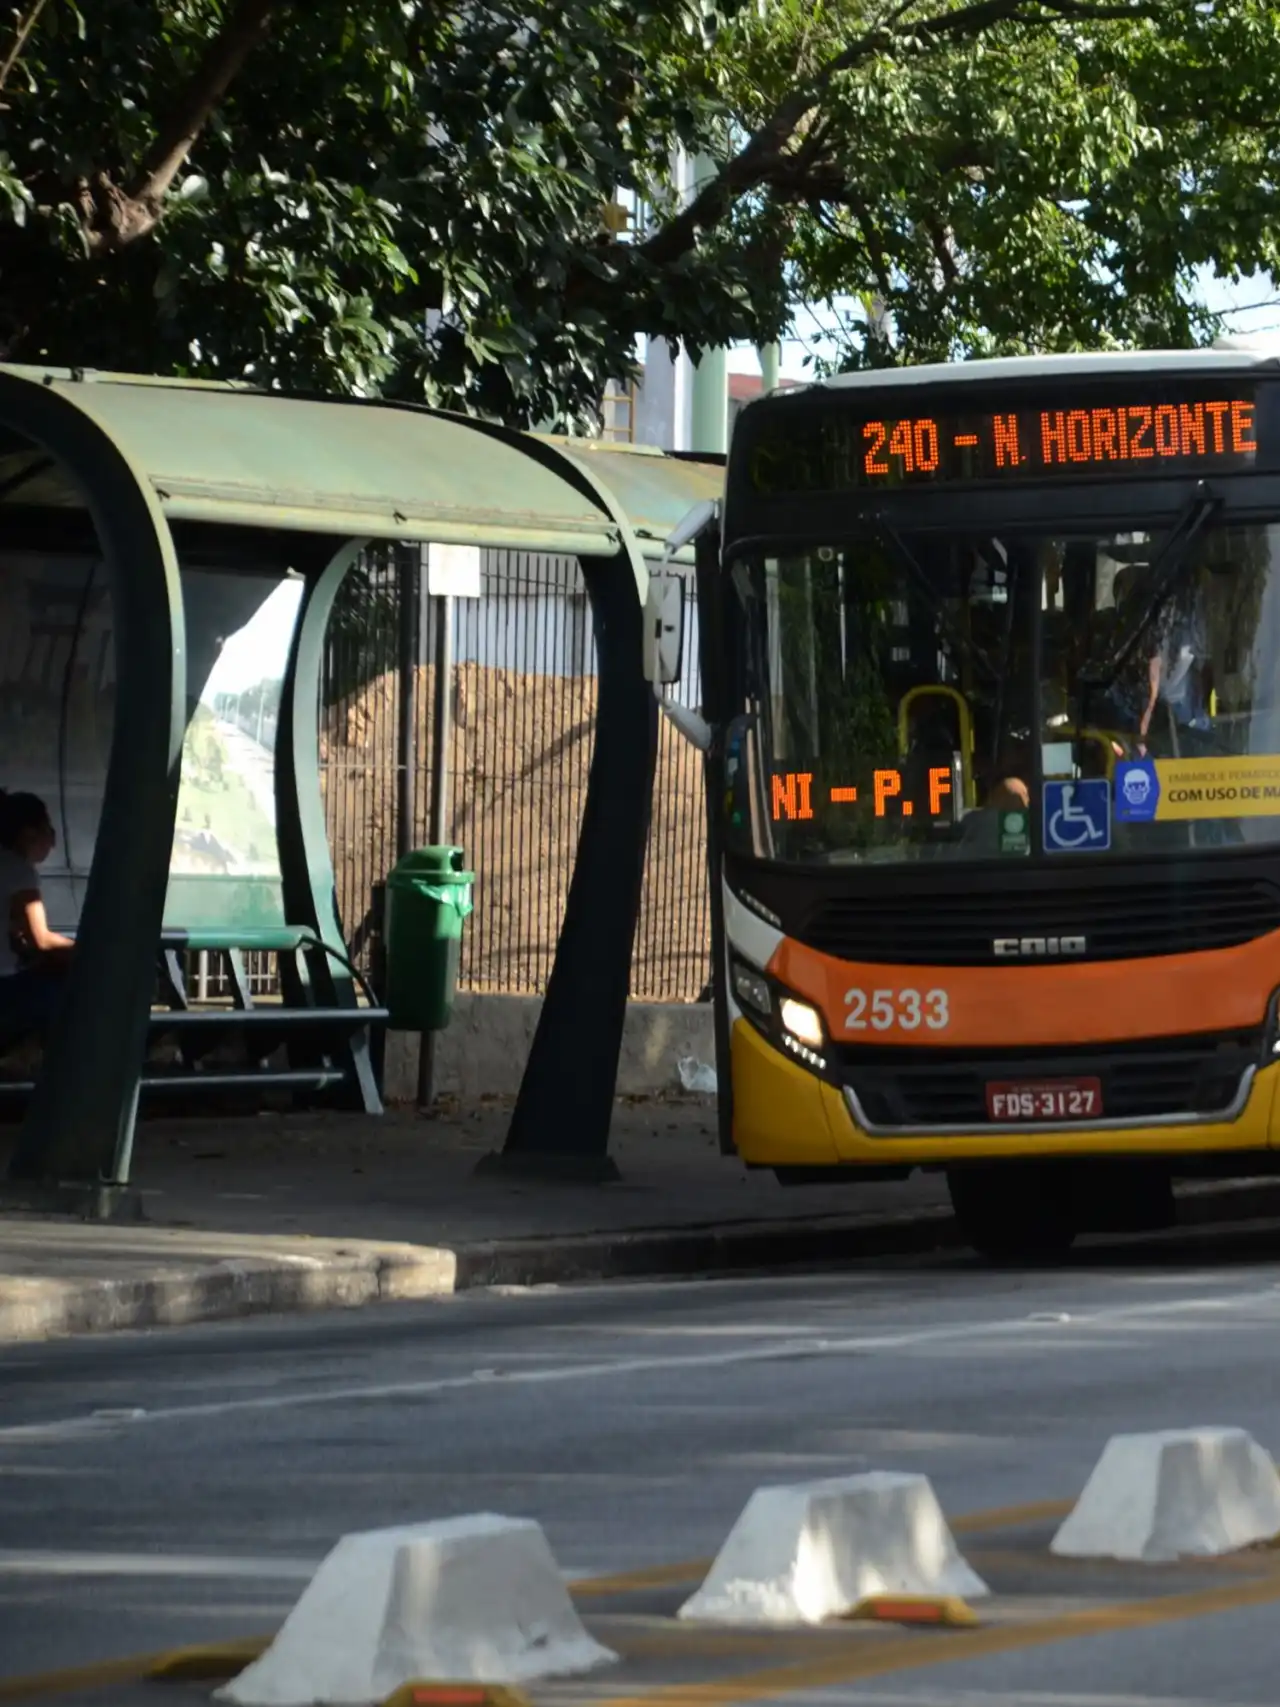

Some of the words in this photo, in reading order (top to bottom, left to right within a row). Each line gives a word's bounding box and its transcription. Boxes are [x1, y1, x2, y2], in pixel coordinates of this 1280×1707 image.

[862, 418, 939, 474] 240
[1040, 400, 1258, 464] HORIZONTE
[771, 772, 814, 821] NI
[1167, 788, 1203, 803] COM
[1205, 786, 1238, 801] USO
[1240, 785, 1262, 799] DE
[843, 987, 950, 1031] 2533
